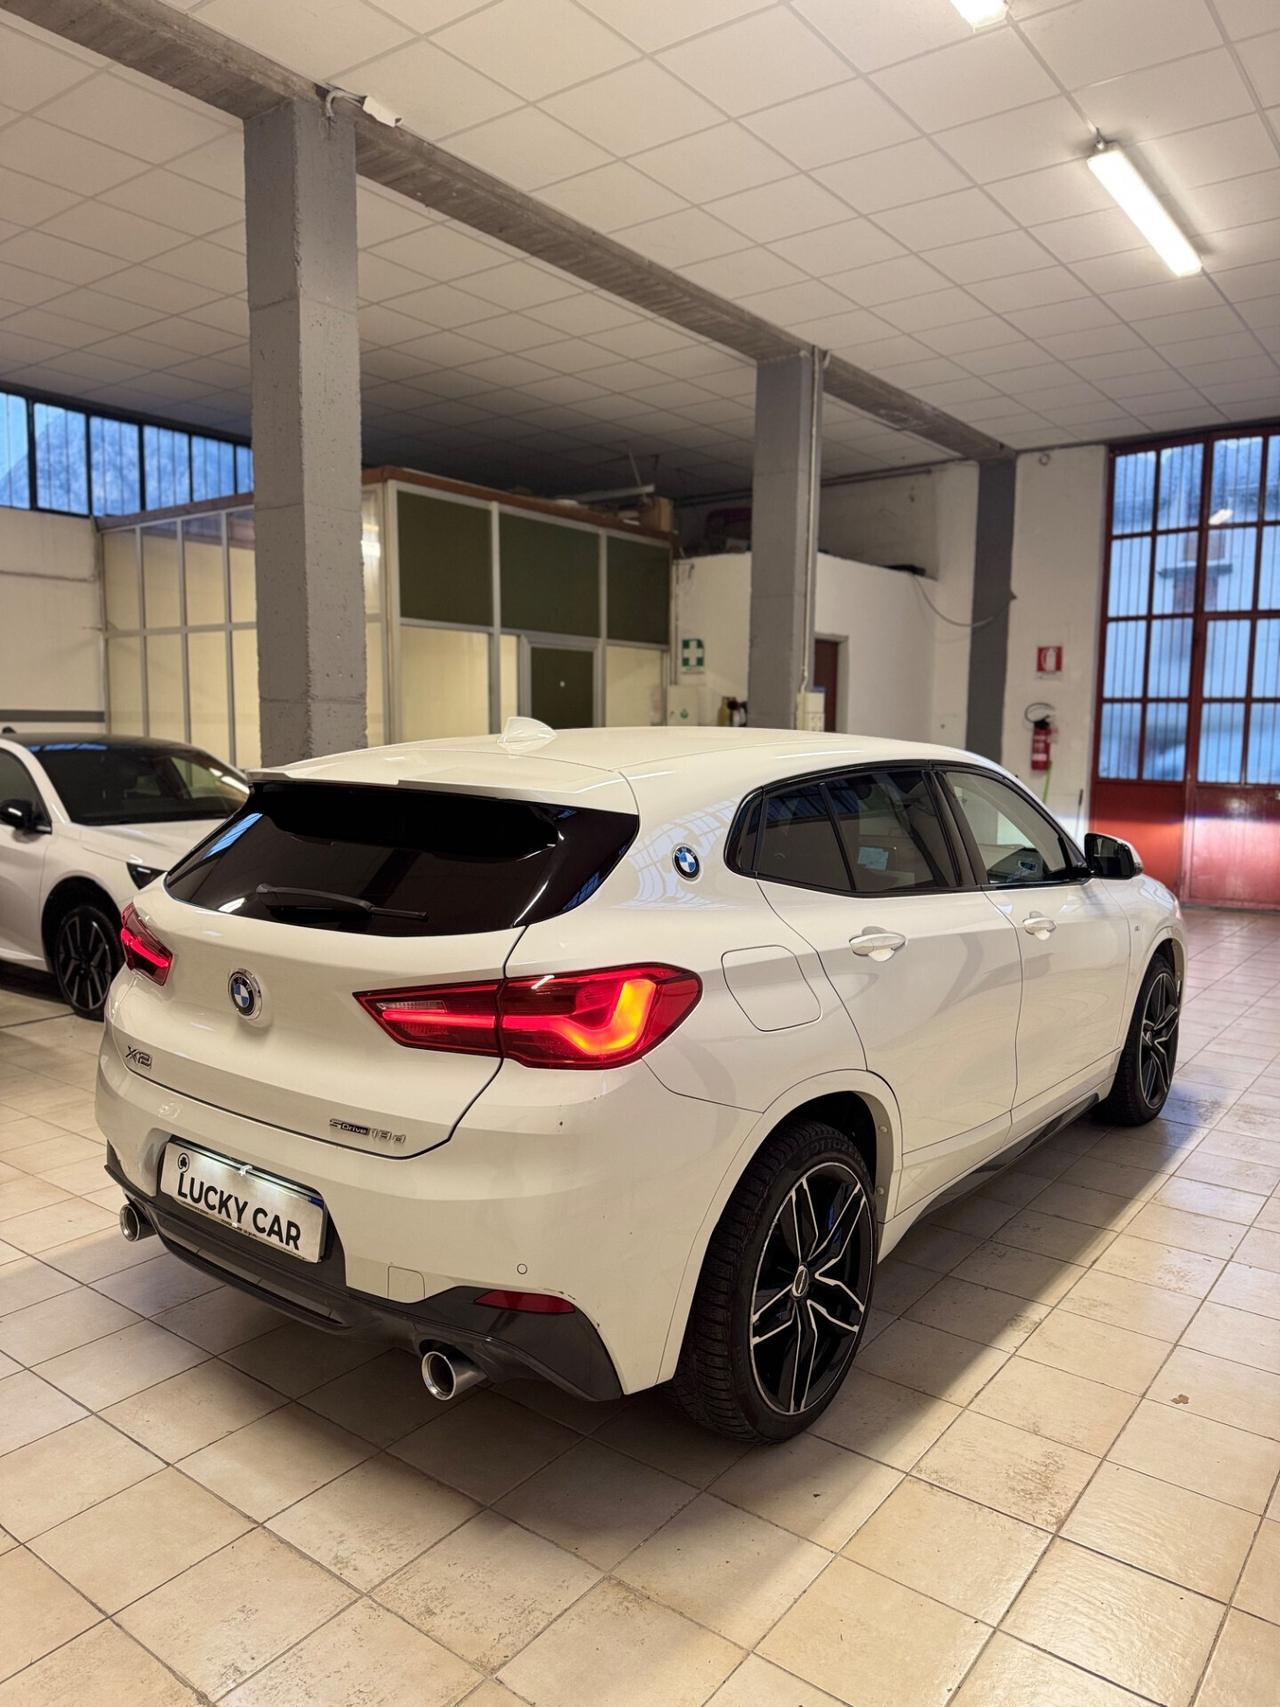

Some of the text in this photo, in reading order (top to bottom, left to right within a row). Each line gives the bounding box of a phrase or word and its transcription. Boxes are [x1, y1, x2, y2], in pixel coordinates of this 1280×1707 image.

[125, 1045, 152, 1069] X2
[177, 1172, 301, 1251] LUCKY CAR
